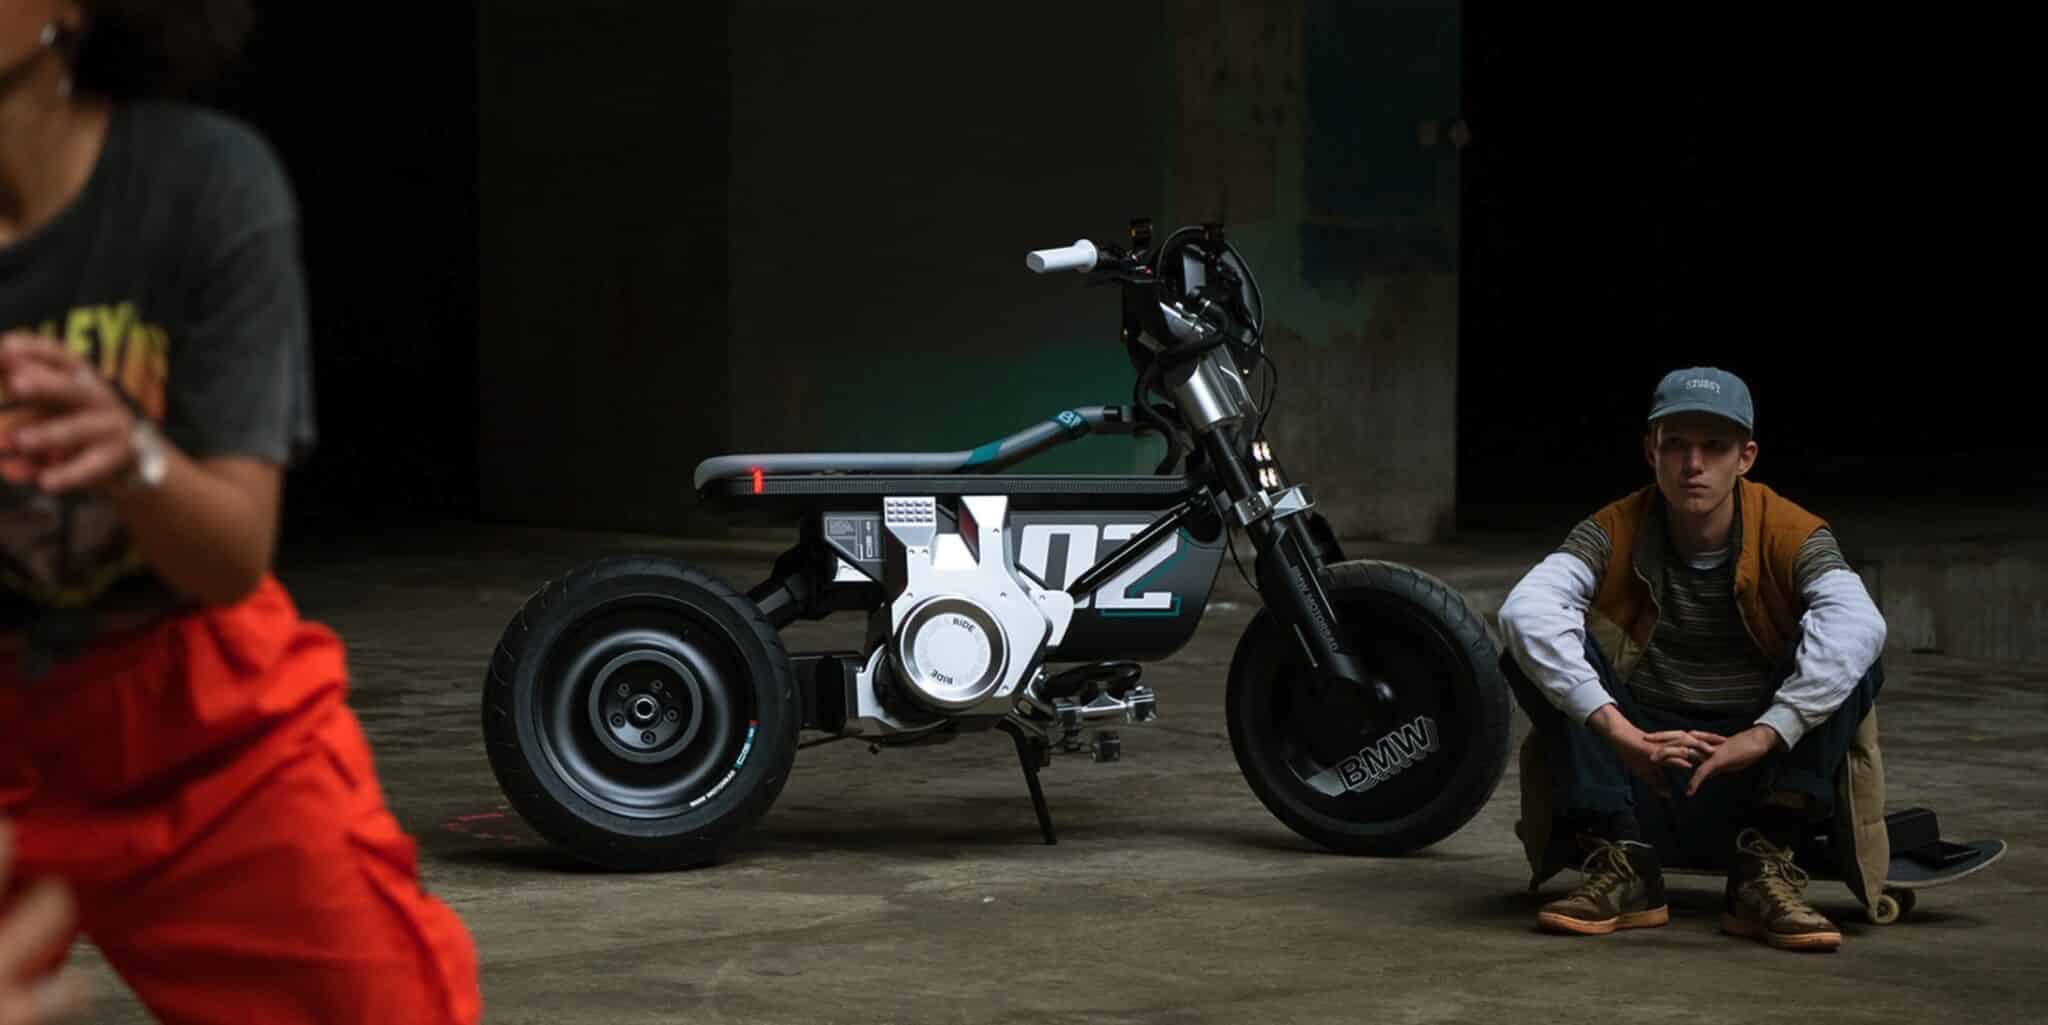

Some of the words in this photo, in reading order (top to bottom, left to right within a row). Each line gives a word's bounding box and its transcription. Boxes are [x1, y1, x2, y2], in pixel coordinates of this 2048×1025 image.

[1019, 524, 1180, 610] 02
[953, 616, 977, 632] RIDE
[931, 669, 954, 685] RIDE
[1336, 714, 1436, 791] BMW
